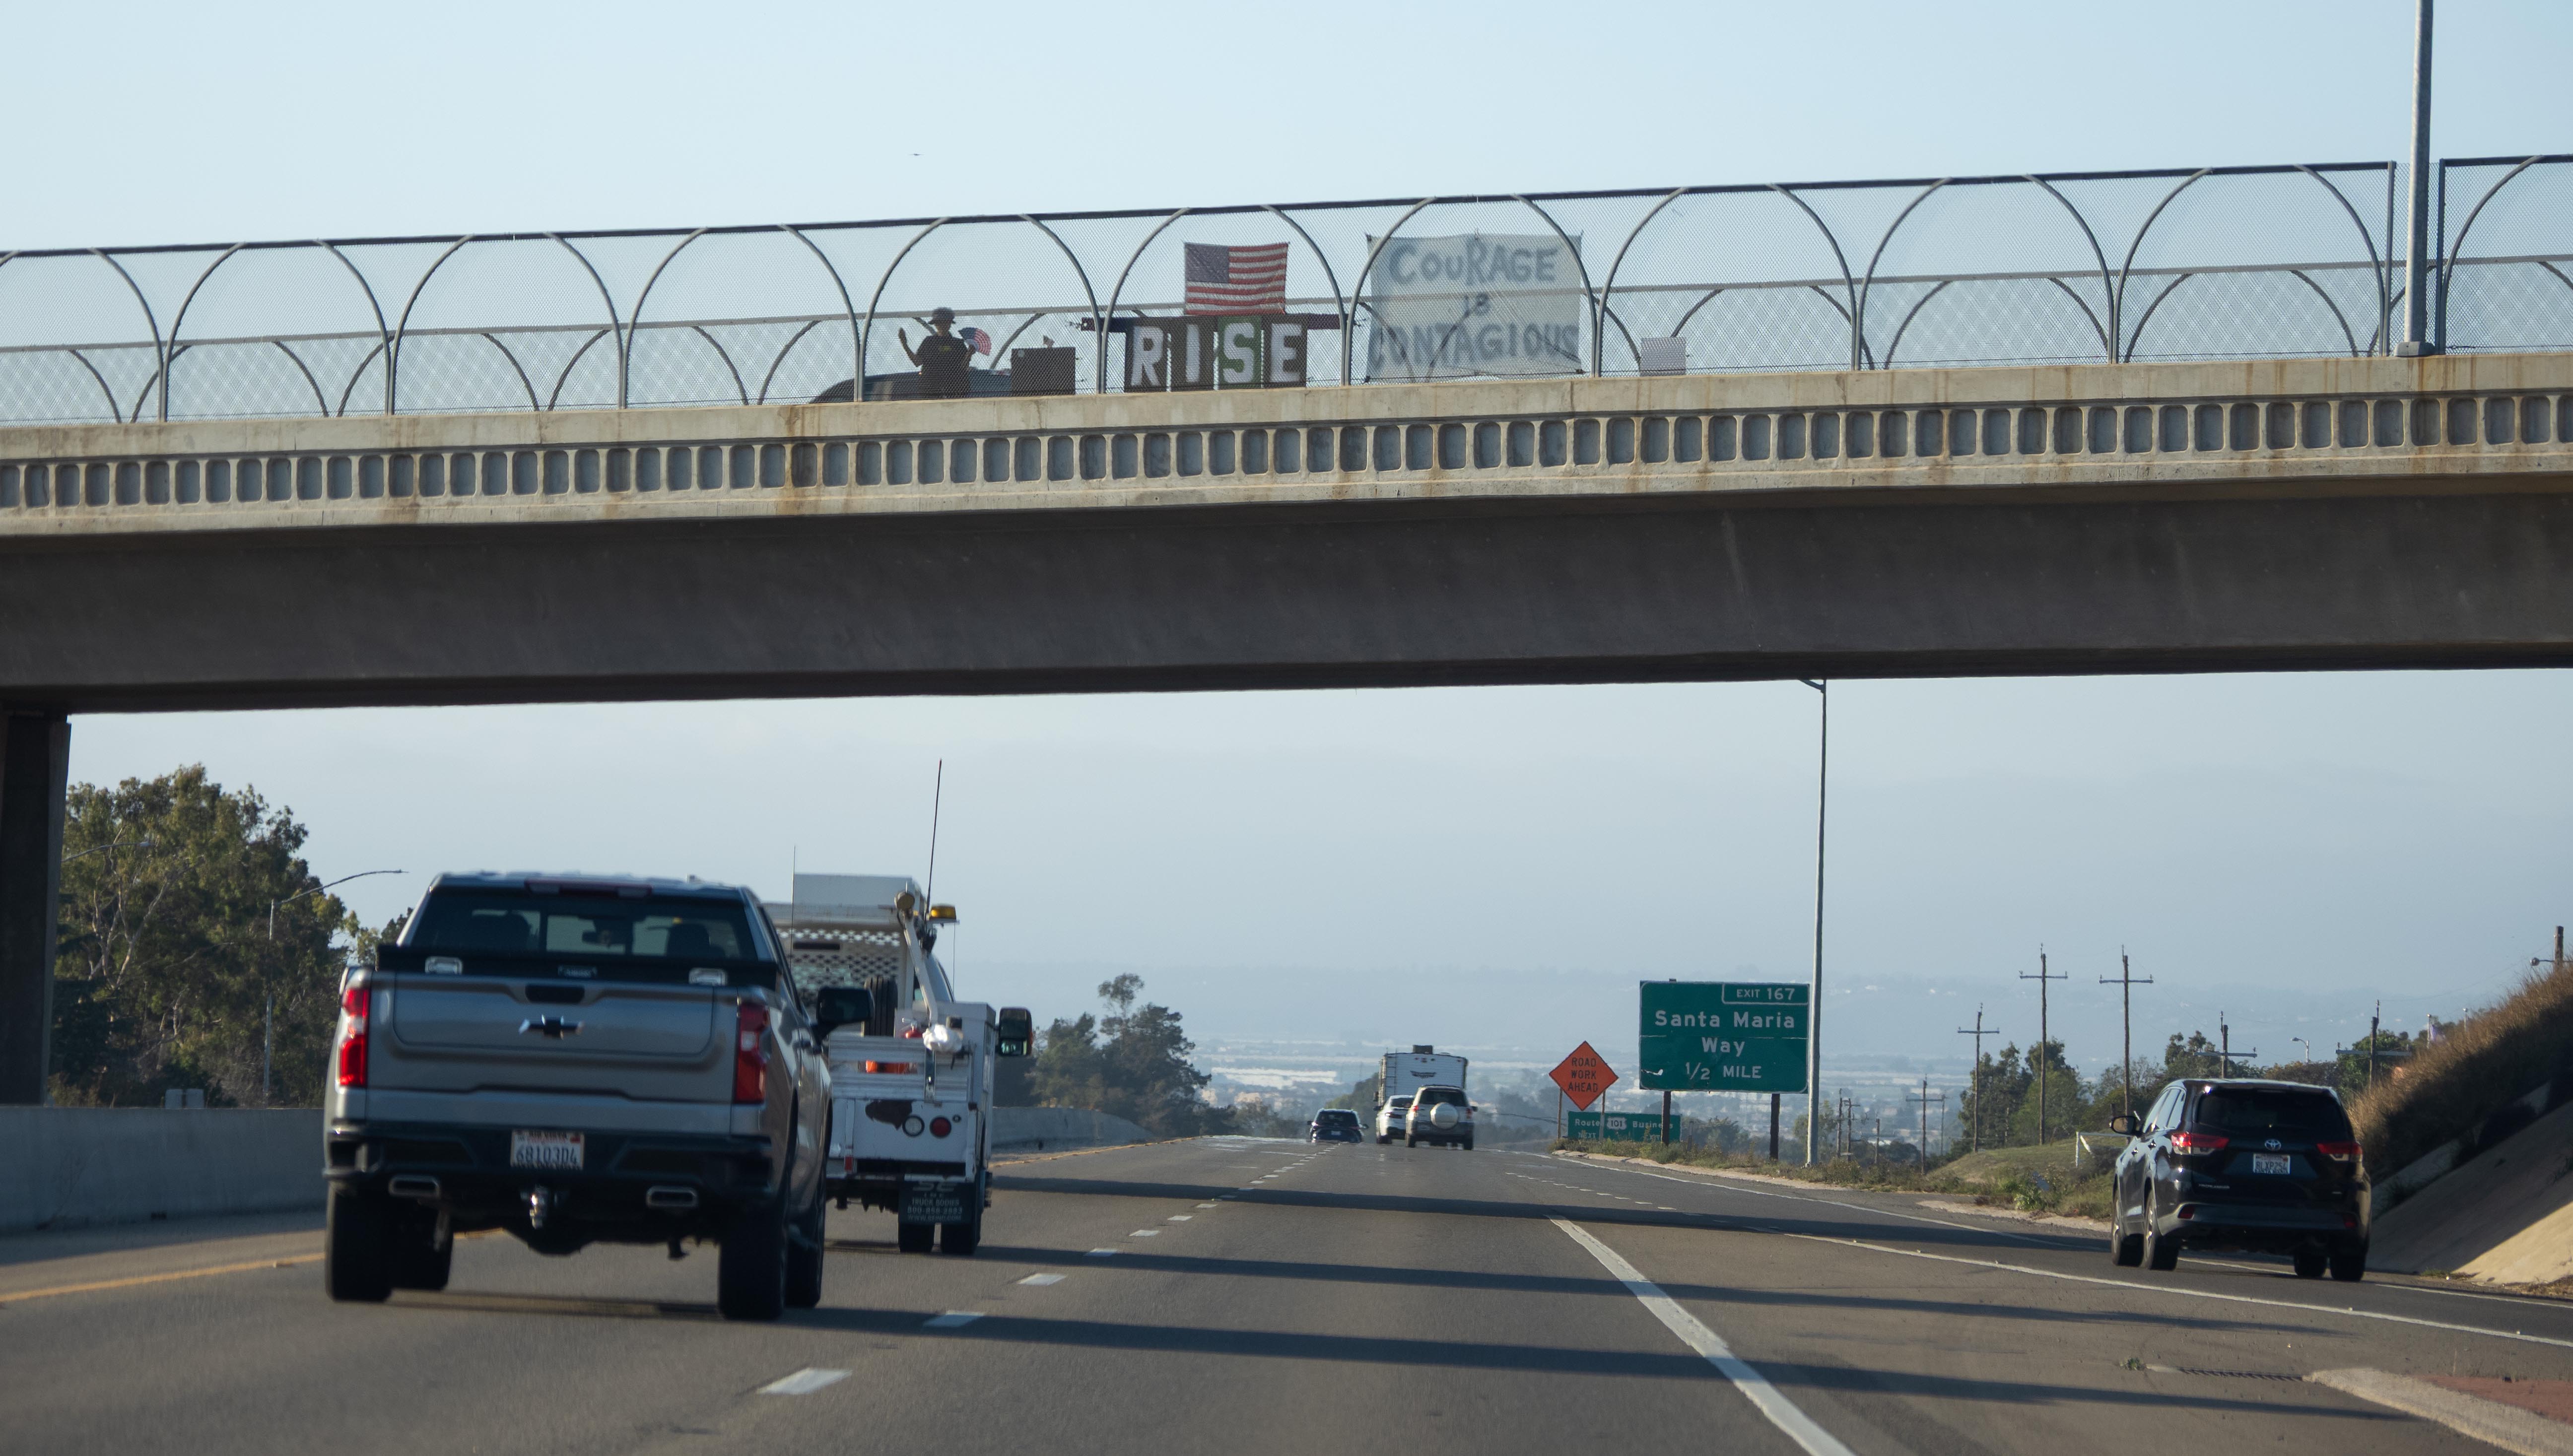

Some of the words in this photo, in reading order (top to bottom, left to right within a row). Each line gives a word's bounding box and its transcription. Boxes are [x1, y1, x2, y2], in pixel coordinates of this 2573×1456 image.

[1131, 322, 1302, 386] RISE
[1368, 322, 1579, 372] CONTAGIOUS
[1737, 989, 1760, 998] EXIT
[1767, 988, 1795, 1000] 167
[1655, 1010, 1720, 1027] Santa
[1734, 1011, 1795, 1028] Maria
[1701, 1037, 1745, 1057] Way
[1571, 1057, 1596, 1067] ROAD
[1686, 1062, 1710, 1080] 1/2
[1723, 1065, 1761, 1078] MILE
[1571, 1070, 1596, 1079] WORK
[1568, 1082, 1598, 1092] AHEAD
